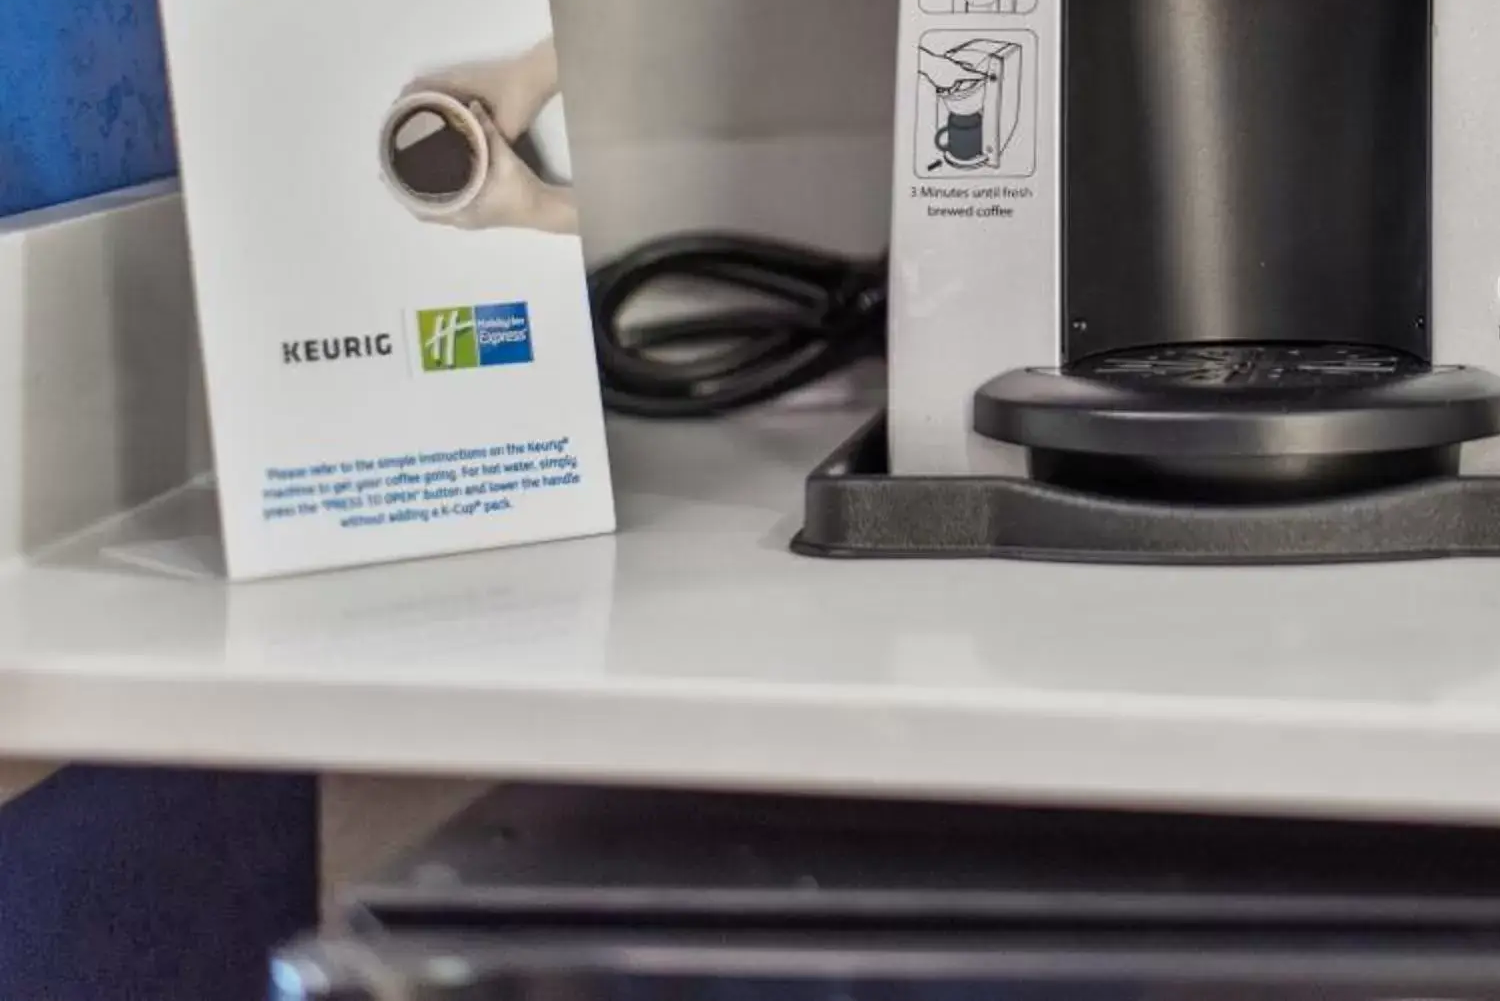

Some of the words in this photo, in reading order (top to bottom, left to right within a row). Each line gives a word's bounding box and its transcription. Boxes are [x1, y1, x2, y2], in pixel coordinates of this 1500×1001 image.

[911, 186, 917, 198] 3
[920, 186, 969, 198] Minutes
[972, 186, 1000, 198] until
[1003, 186, 1034, 199] fresh
[927, 205, 974, 217] brewed
[975, 205, 1014, 217] coffee
[282, 333, 393, 365] KEURIG
[507, 443, 526, 455] the
[539, 455, 578, 471] simply
[521, 477, 540, 489] the
[542, 471, 581, 487] handle
